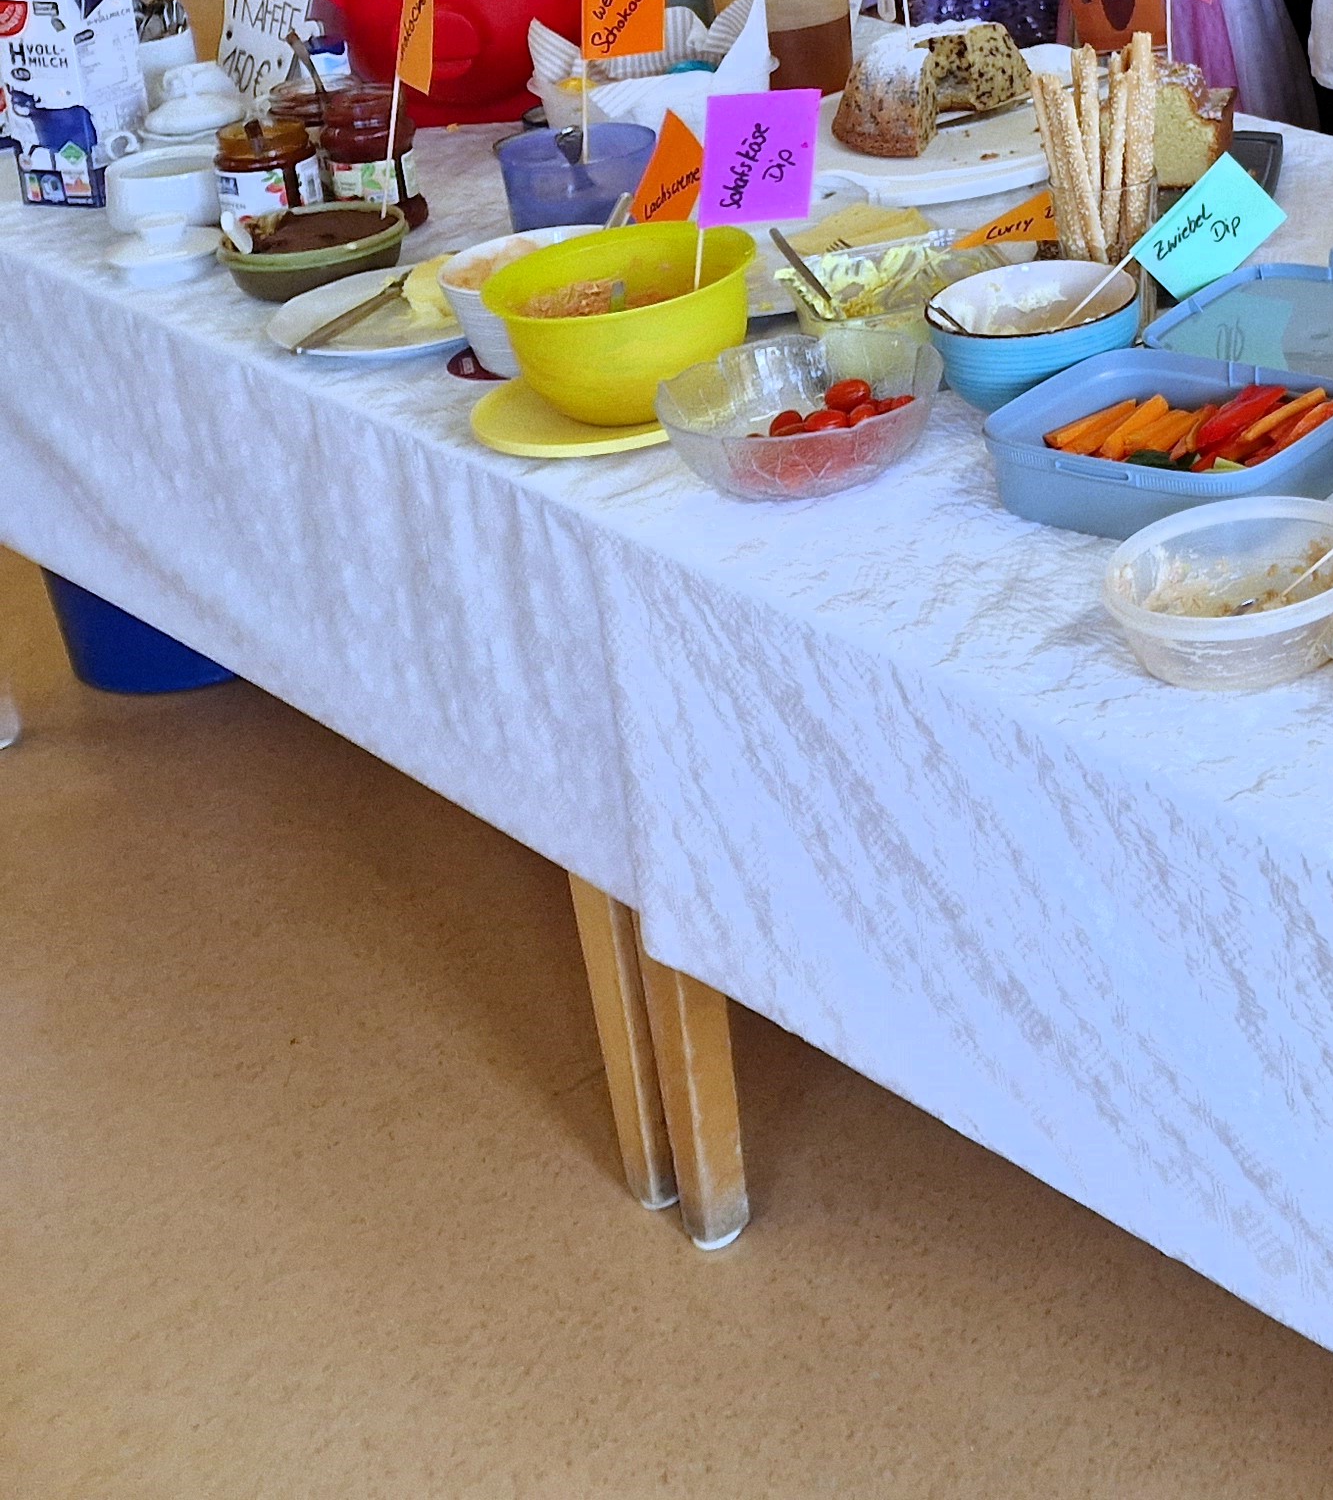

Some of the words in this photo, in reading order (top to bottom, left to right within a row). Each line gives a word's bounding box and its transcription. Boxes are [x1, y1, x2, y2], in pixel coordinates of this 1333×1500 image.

[26, 43, 65, 56] VOLL-
[27, 56, 69, 69] MILCH
[762, 149, 796, 183] Dip
[986, 217, 1034, 241] Curry
[1153, 203, 1213, 261] Zwiebel
[1210, 216, 1241, 243] Dip
